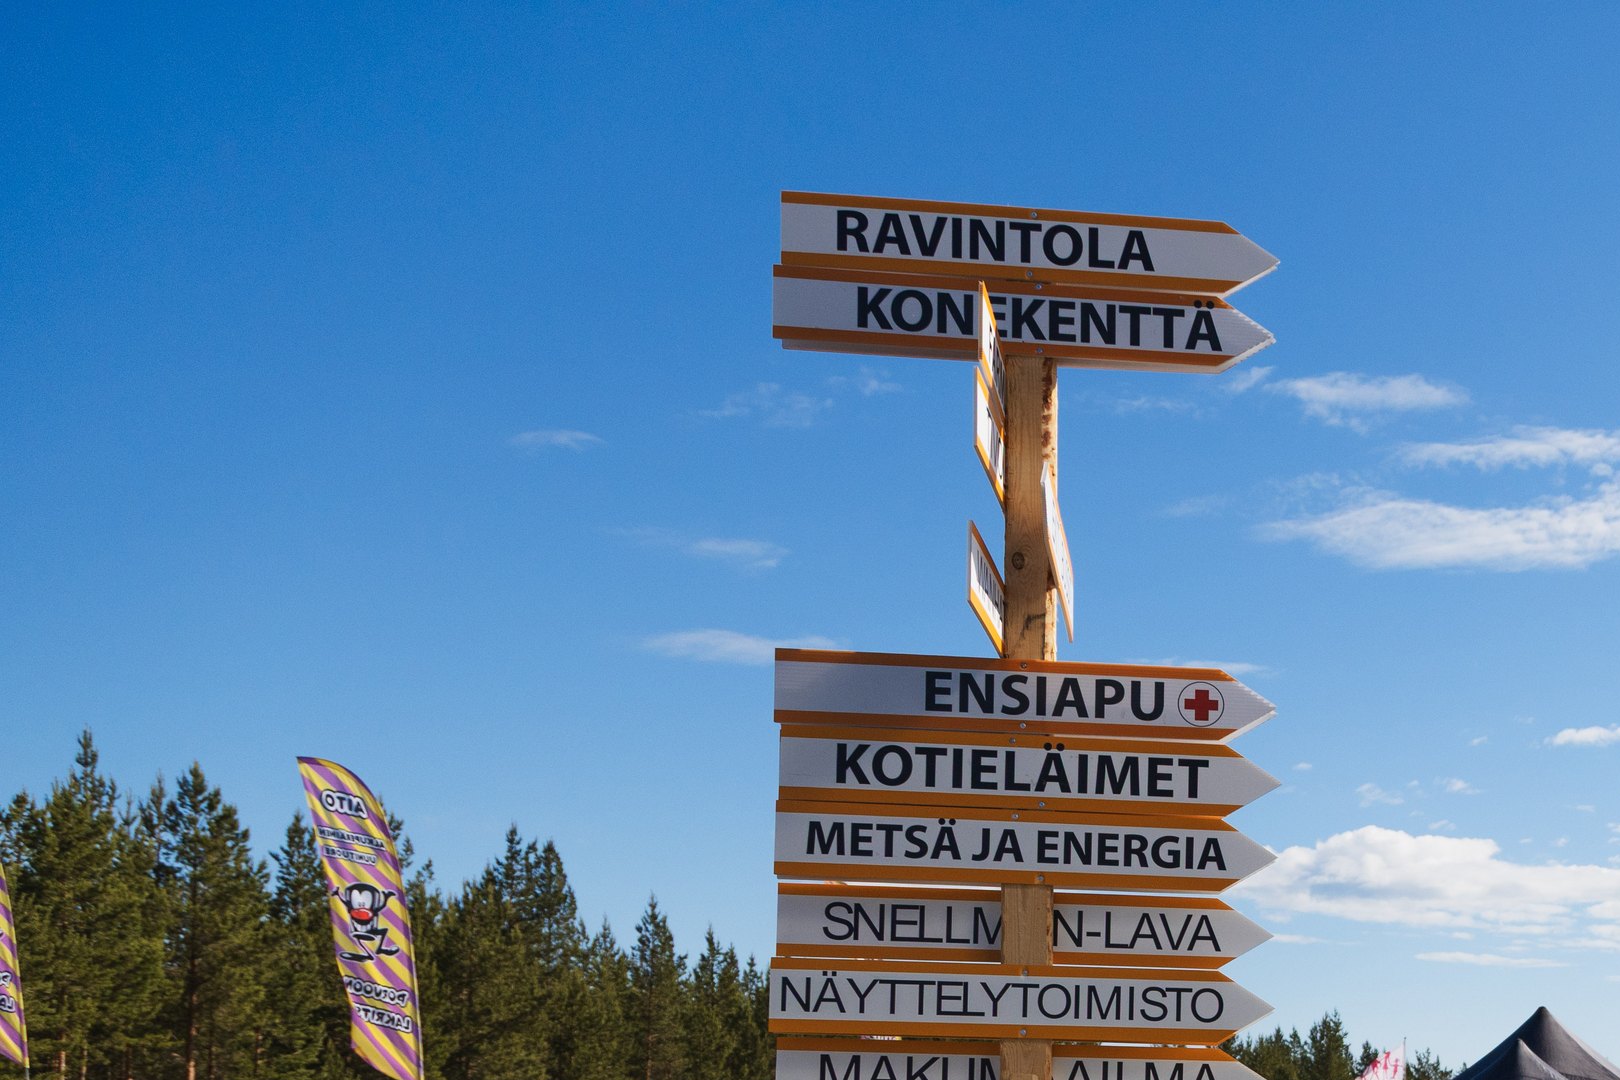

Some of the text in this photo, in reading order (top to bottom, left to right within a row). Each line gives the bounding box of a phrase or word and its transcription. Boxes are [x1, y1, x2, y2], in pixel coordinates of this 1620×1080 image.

[836, 210, 1155, 272] RAVINTOLA
[857, 286, 1222, 352] KONEKENTTÄ
[924, 671, 1165, 722] ENSIAPU
[836, 742, 1208, 799] KOTIELÄIMET
[807, 818, 1227, 871] METSÄ JA ENERGIA
[823, 902, 1221, 951] SNELLMN-LAVA
[781, 971, 1224, 1023] NÄYTTELYTOIMISTO
